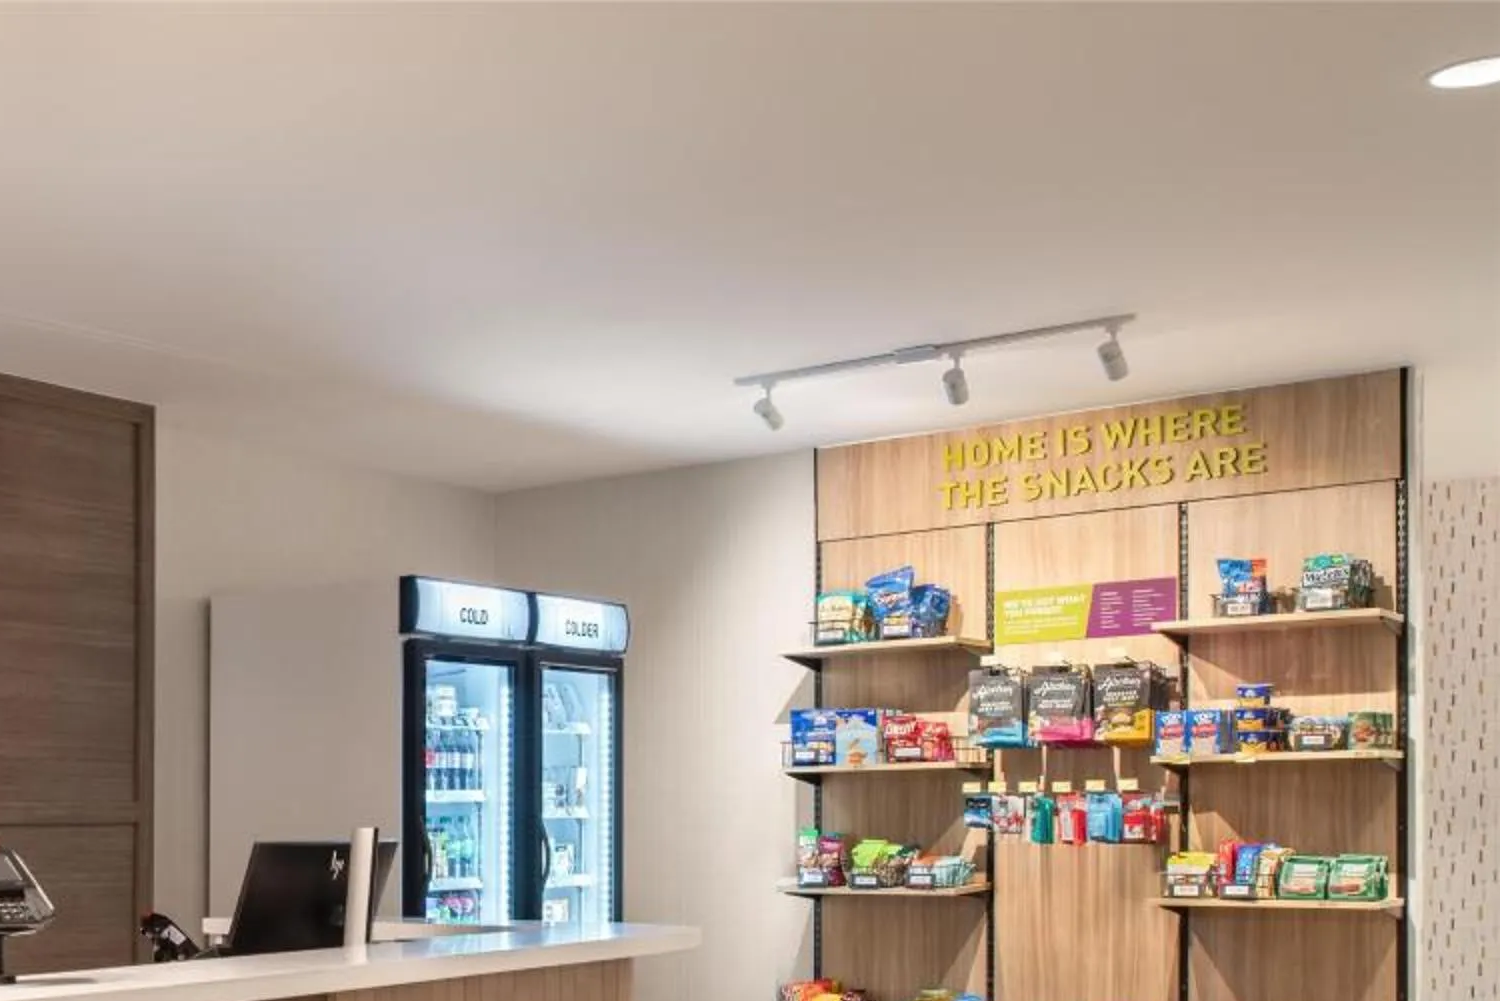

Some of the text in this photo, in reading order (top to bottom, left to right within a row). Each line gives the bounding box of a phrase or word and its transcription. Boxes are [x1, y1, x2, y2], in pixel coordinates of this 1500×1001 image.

[942, 404, 1247, 472] HOME IS WHERE
[940, 441, 1268, 510] THE SNACKS ARE
[459, 607, 489, 626] COLD
[565, 618, 599, 639] COLDER
